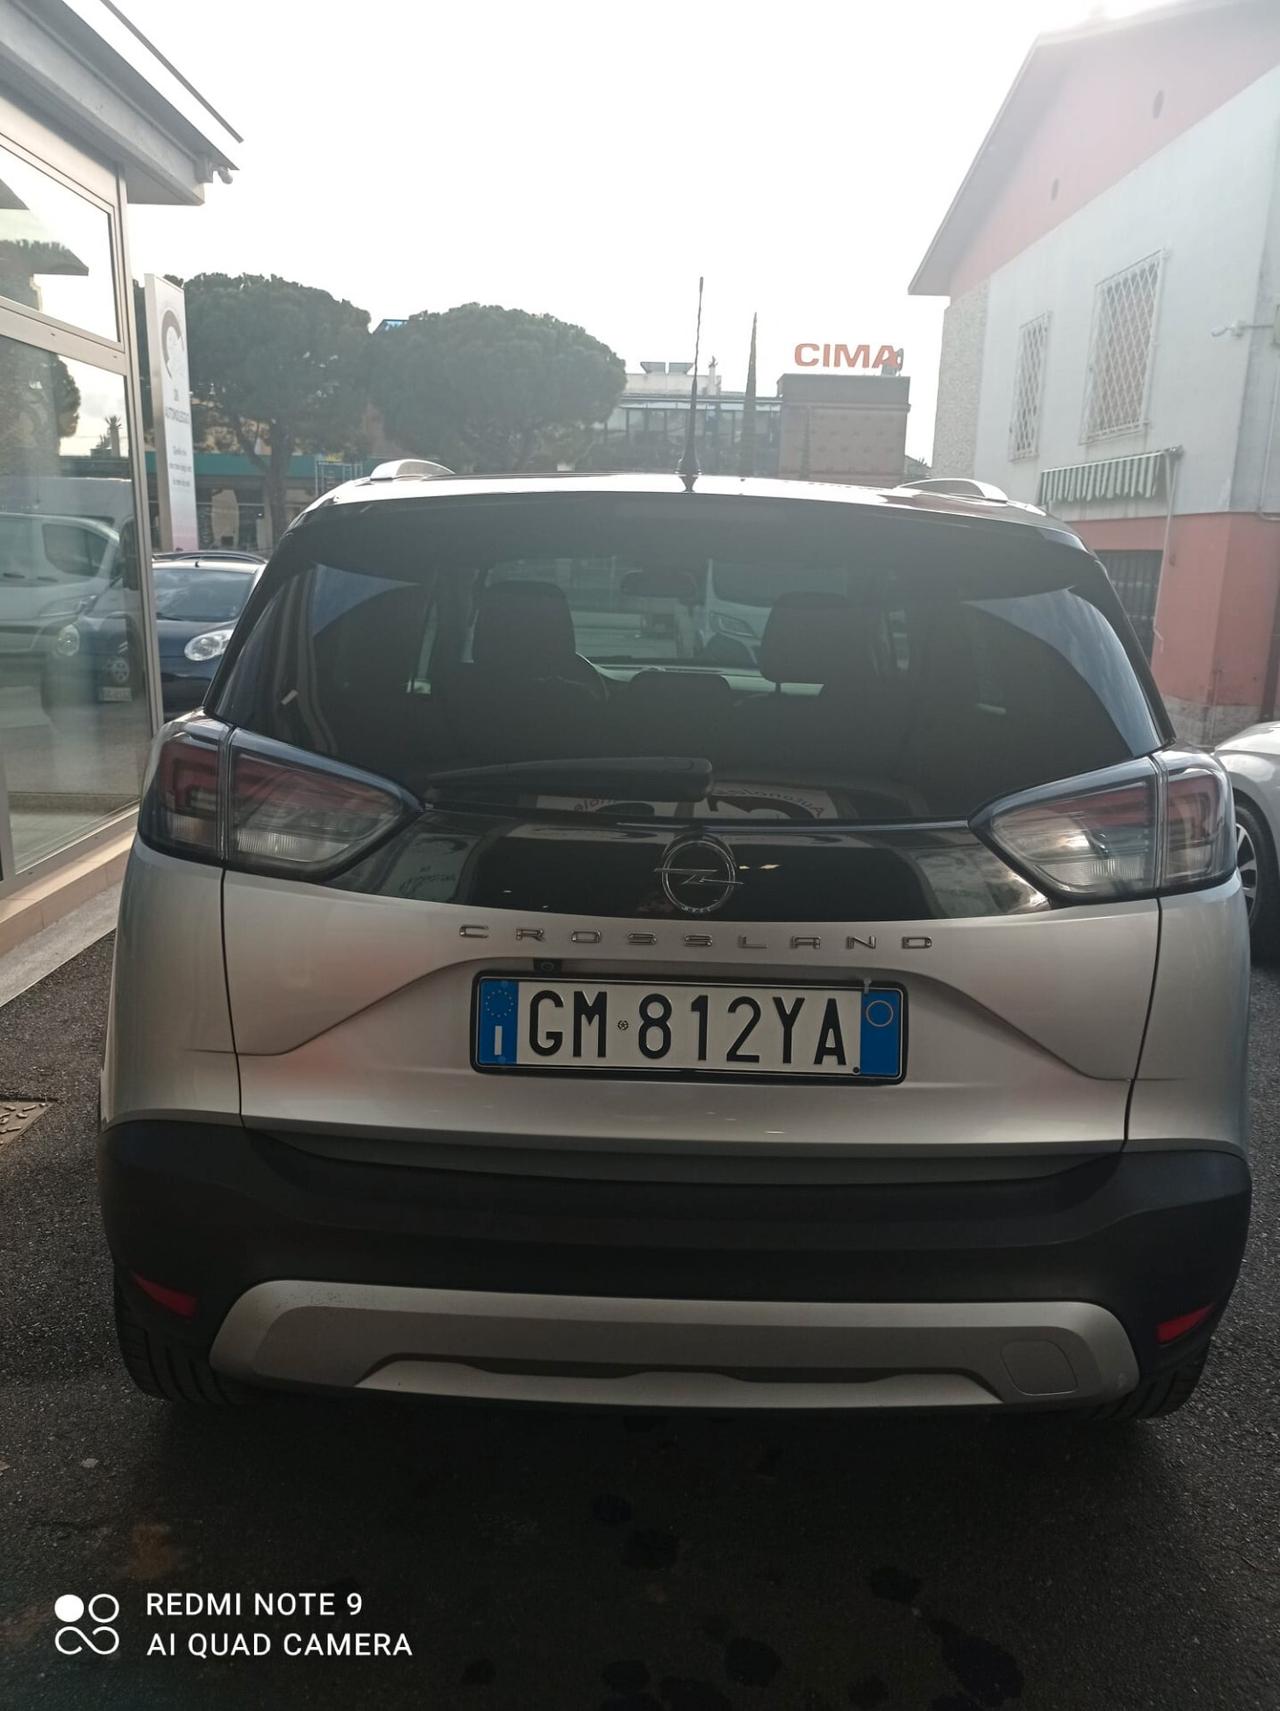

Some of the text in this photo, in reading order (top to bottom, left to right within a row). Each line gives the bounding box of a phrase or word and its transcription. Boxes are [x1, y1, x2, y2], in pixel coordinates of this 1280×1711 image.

[793, 343, 899, 369] CIMA
[459, 924, 933, 950] CROSSLAND
[529, 989, 608, 1059] GM
[638, 992, 847, 1066] 812YA
